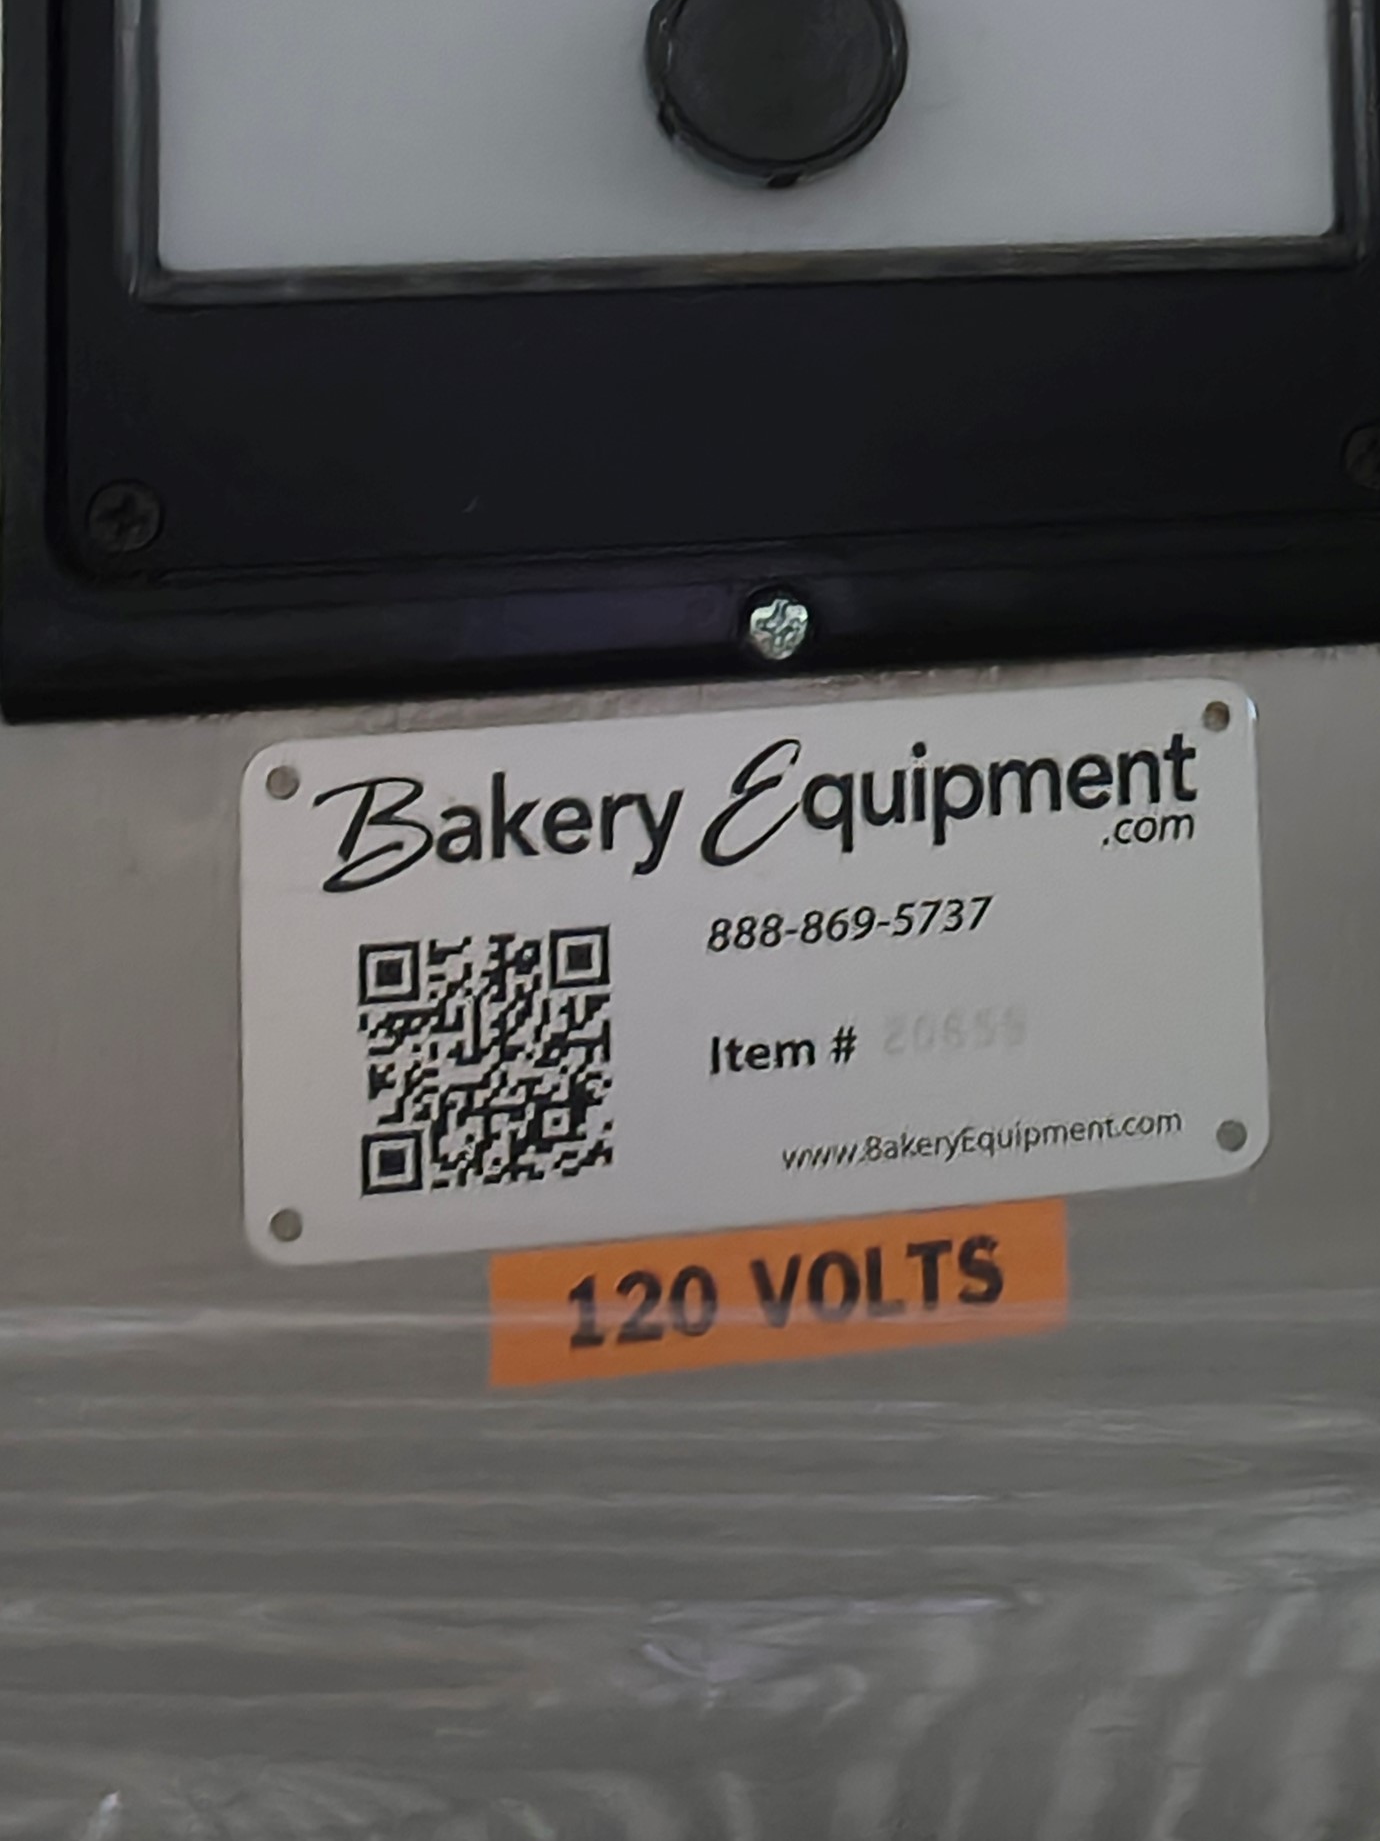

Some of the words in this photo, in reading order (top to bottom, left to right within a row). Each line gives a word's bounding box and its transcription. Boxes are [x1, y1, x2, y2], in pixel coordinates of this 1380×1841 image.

[313, 771, 684, 893] Bakery
[701, 733, 1198, 866] Equipment
[1102, 812, 1195, 847] .com
[707, 895, 993, 952] 888-869-5737
[710, 1036, 816, 1075] Item
[830, 1025, 857, 1064] #
[781, 1112, 1182, 1170] www.BakeryEquipment.com
[568, 1265, 718, 1351] 120
[750, 1236, 1005, 1328] VOLTS
